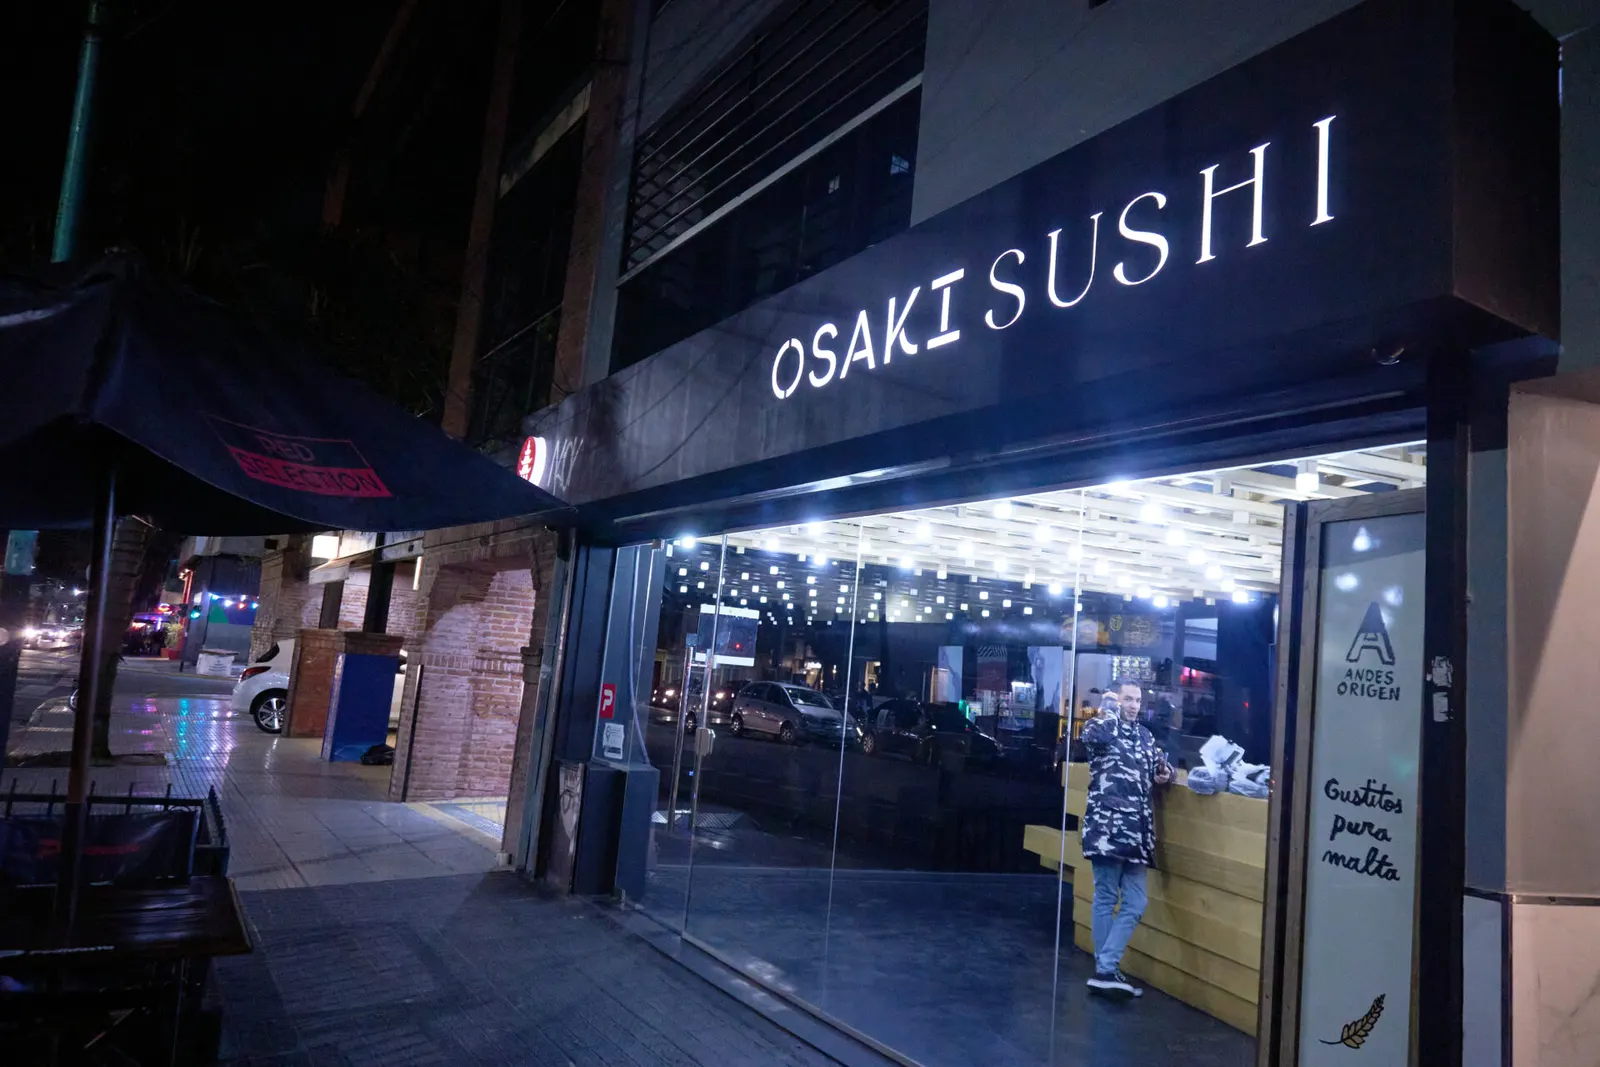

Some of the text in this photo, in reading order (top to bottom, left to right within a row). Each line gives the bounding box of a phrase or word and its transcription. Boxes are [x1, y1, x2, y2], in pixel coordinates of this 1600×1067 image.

[770, 115, 1338, 400] OSAKI SUSHI
[257, 434, 316, 463] RED
[234, 452, 384, 492] SELECTION
[1337, 681, 1401, 701] ORIGEN
[1344, 668, 1394, 685] ANDES
[1324, 778, 1403, 814] Gustitos
[1329, 814, 1392, 842] pura
[1322, 846, 1401, 881] malta
